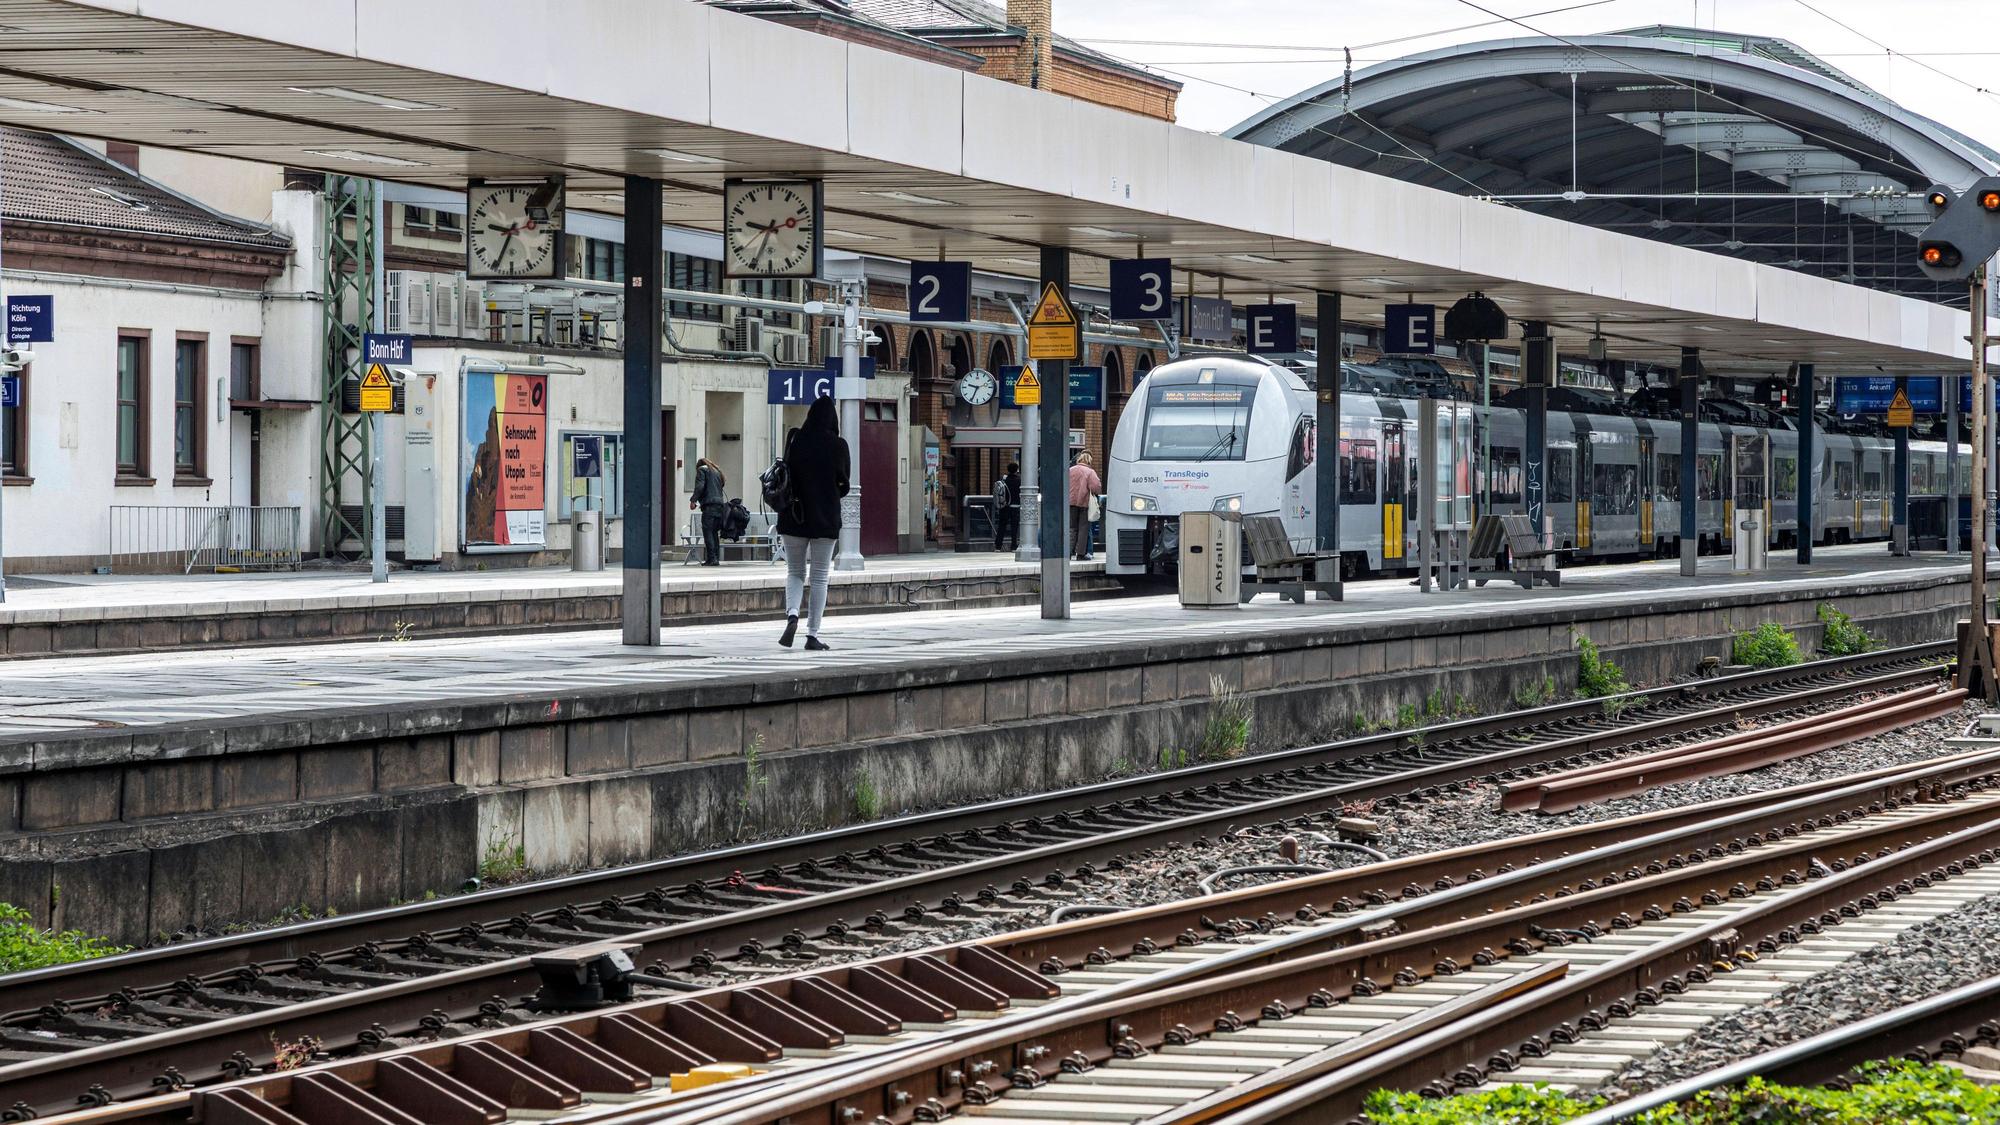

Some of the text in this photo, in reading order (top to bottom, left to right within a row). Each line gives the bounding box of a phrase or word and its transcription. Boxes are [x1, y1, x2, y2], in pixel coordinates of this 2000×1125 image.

[918, 274, 940, 314] 2
[1139, 272, 1163, 312] 3
[11, 304, 41, 314] Richtung
[11, 314, 27, 322] Köln
[1193, 304, 1224, 332] Bonn Hbf
[1254, 316, 1275, 347] E
[1408, 316, 1428, 347] E
[370, 339, 404, 359] Bonn Hbf
[783, 377, 796, 400] 1
[814, 378, 831, 399] G
[505, 424, 537, 440] Sehnsucht
[505, 444, 520, 459] nach
[505, 463, 526, 482] Utopia
[1164, 470, 1209, 479] TransRegio
[1215, 542, 1223, 593] Abfall
